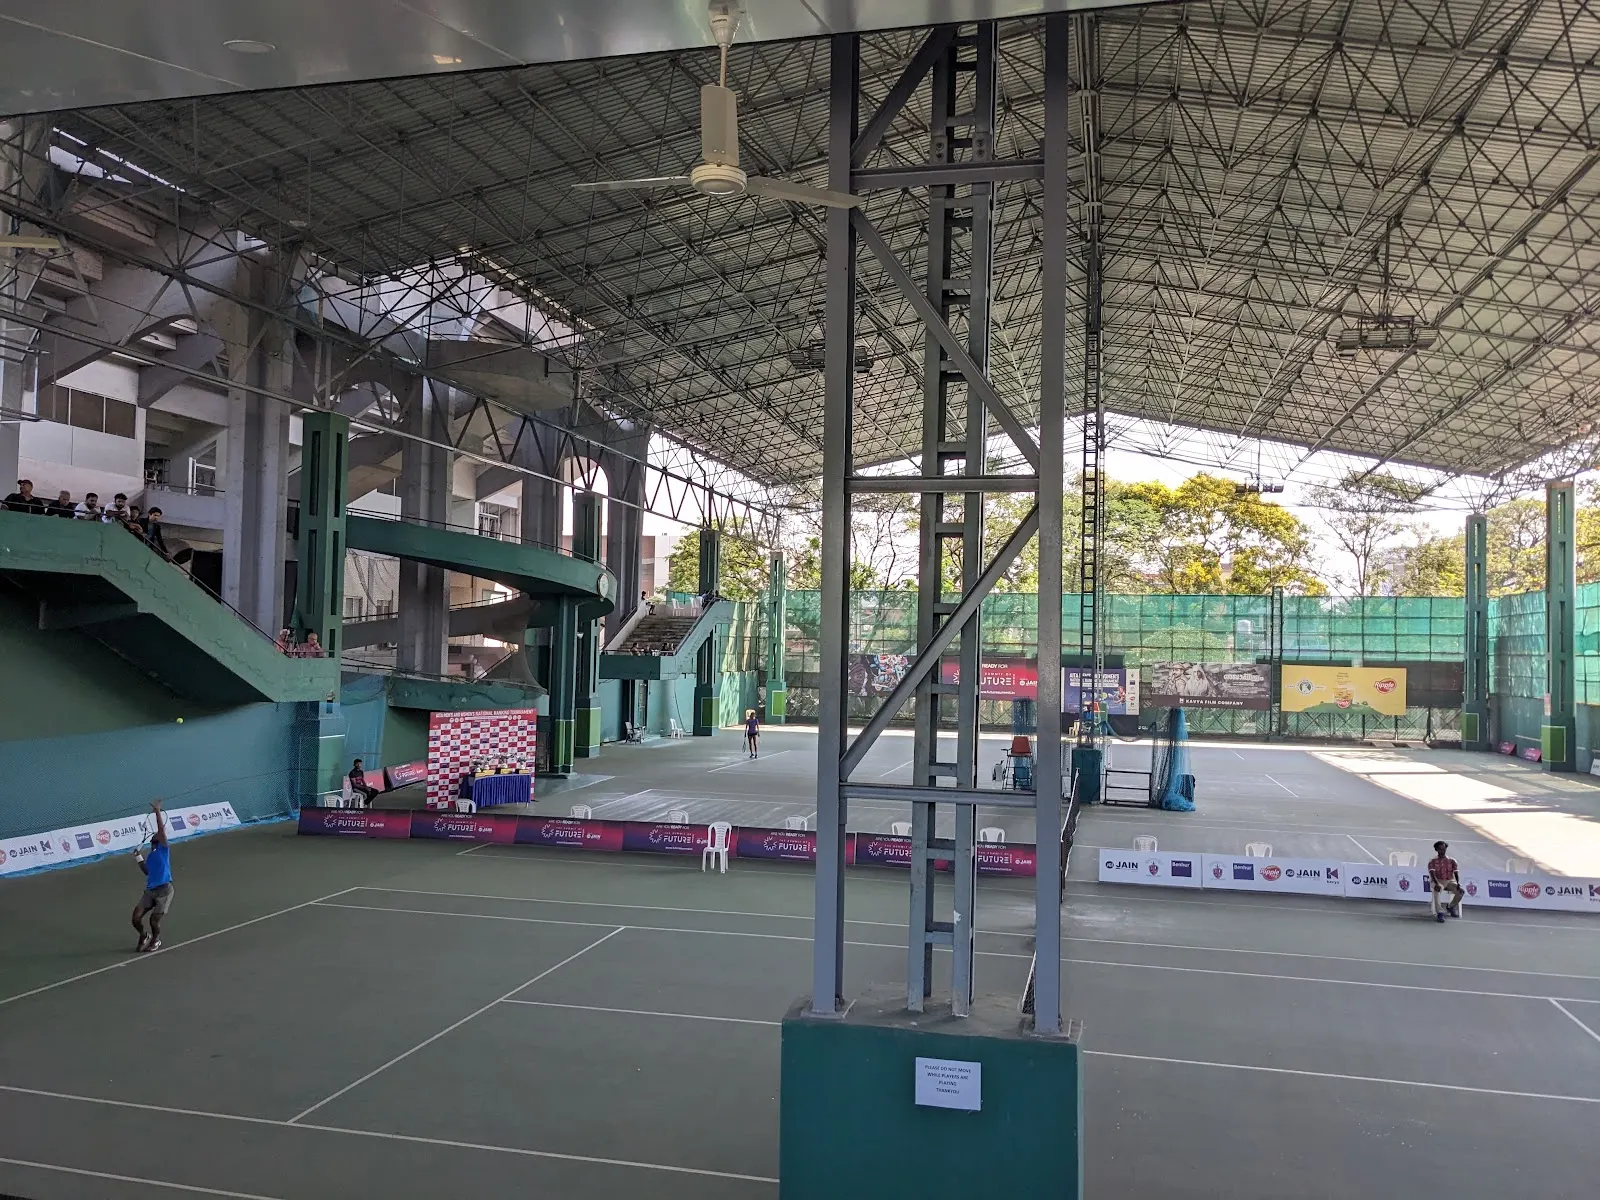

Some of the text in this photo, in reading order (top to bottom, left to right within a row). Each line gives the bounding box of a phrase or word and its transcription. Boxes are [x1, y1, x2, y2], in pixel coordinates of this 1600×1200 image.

[980, 677, 1012, 686] UTURE
[1374, 681, 1395, 691] Ripple
[120, 826, 137, 835] JAIN
[448, 824, 474, 832] FUTURE
[555, 830, 582, 838] FUTURE
[663, 835, 692, 843] FUTURE
[19, 845, 38, 855] JAIN
[778, 843, 808, 852] FUTURE
[978, 855, 1009, 864] FUTURE
[1116, 861, 1138, 869] JAIN
[1260, 868, 1280, 876] Ripple
[1297, 869, 1320, 877] JAIN
[1363, 876, 1388, 885] JAIN
[1558, 887, 1582, 895] JAIN
